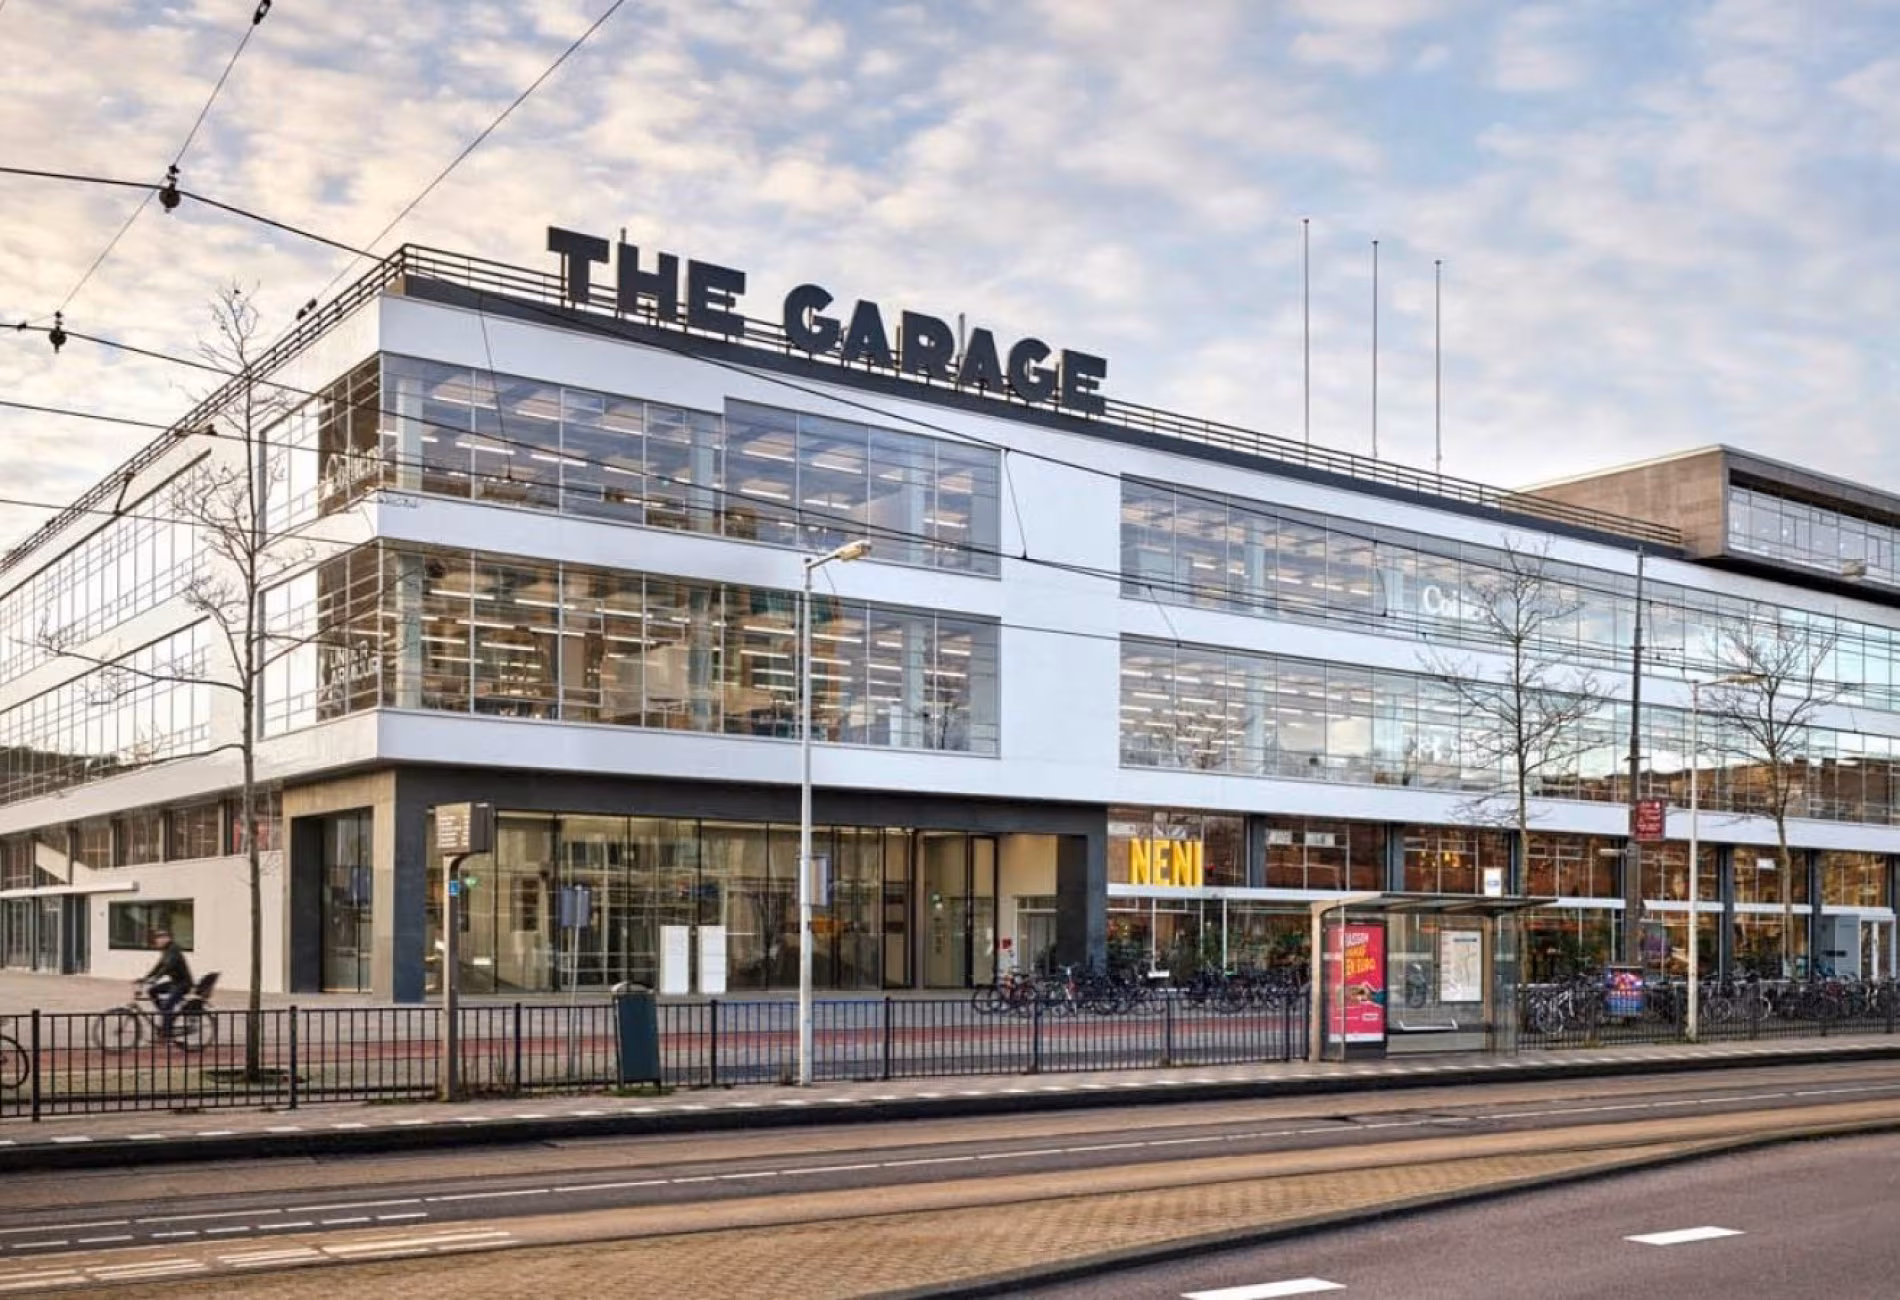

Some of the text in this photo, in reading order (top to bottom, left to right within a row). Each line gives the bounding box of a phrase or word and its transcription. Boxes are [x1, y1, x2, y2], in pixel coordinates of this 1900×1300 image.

[547, 226, 1108, 416] THE GARAGE
[1129, 837, 1204, 887] NENI
